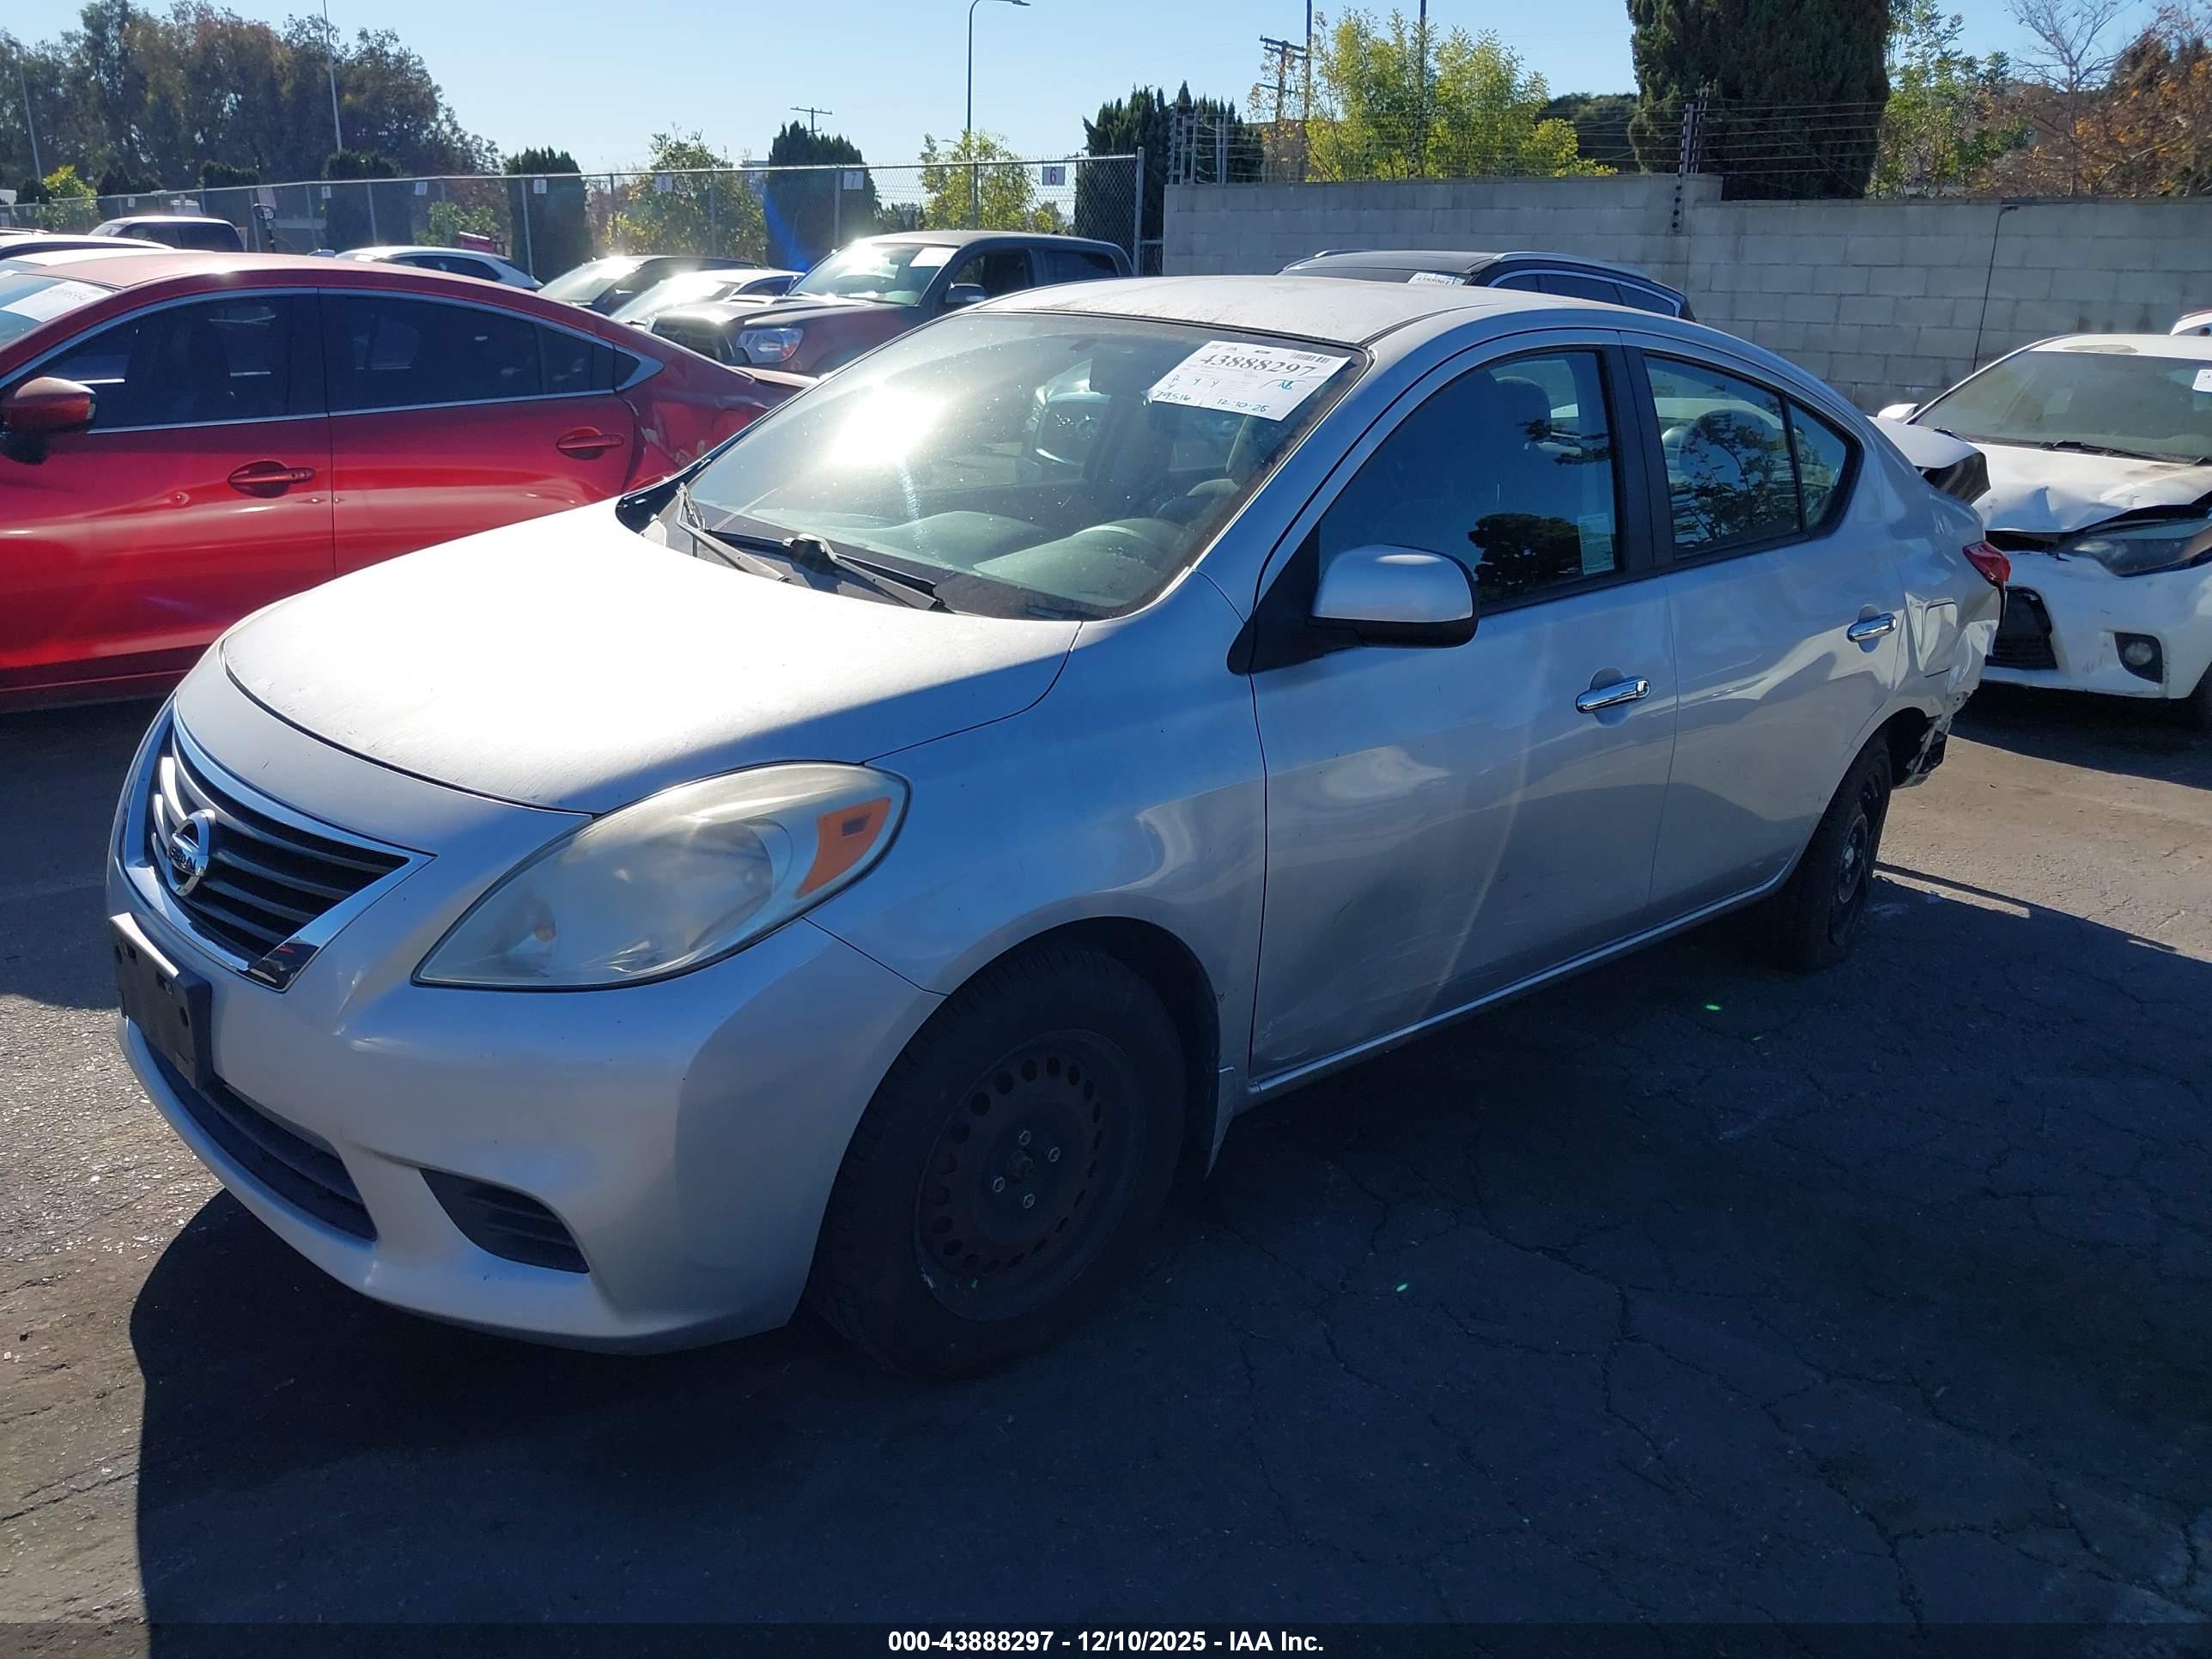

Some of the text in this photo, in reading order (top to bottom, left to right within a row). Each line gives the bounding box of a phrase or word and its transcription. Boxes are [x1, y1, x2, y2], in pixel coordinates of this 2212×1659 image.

[851, 172, 858, 187] 7
[1049, 167, 1057, 185] 6
[1200, 353, 1317, 377] 43888297
